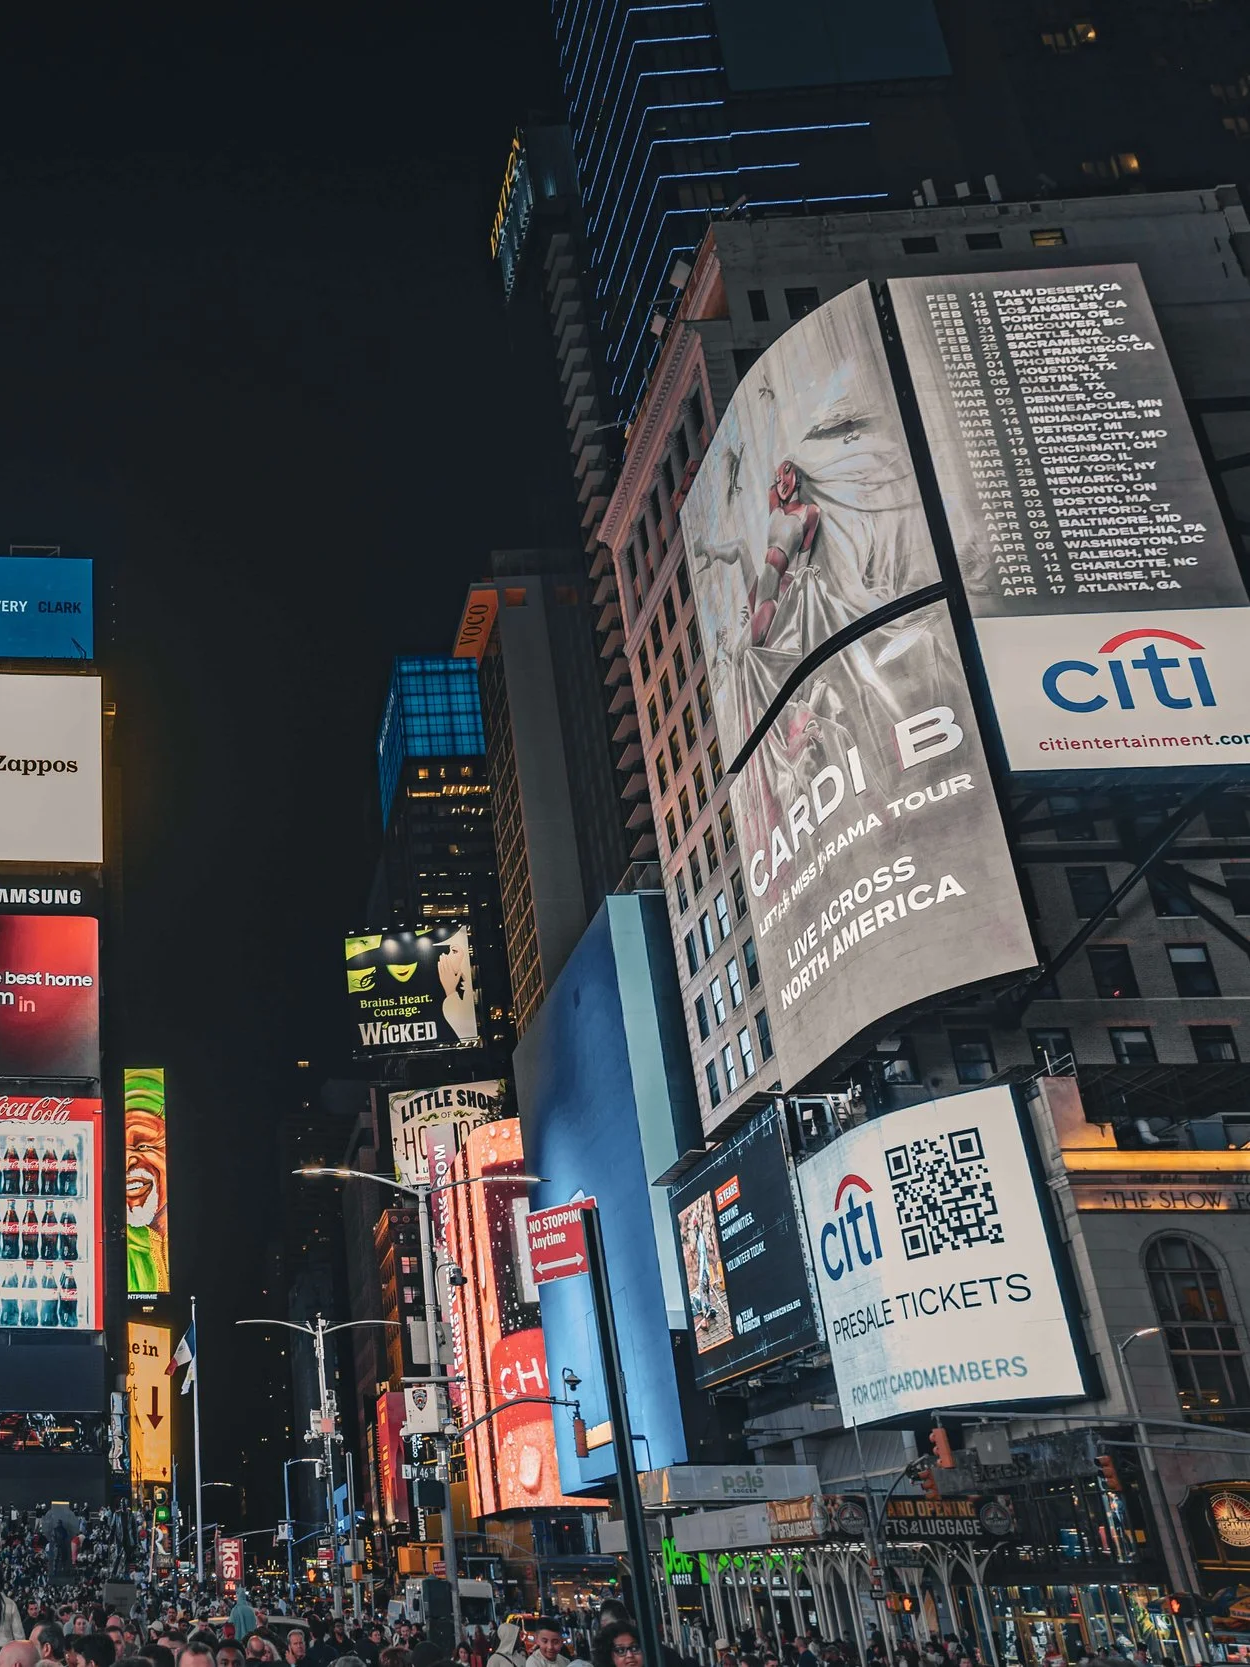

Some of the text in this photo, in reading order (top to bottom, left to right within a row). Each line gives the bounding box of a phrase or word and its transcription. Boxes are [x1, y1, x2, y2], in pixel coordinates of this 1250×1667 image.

[926, 294, 957, 303] FEB
[993, 289, 1032, 298] PALM
[1036, 285, 1097, 296] DESERT,
[1100, 283, 1122, 291] CA
[933, 319, 964, 328] FEB
[1001, 312, 1085, 324] PORTLAND,
[1088, 310, 1109, 318] OR
[949, 373, 1101, 388] MAR 06 AUSTIN, TX
[962, 428, 995, 438] MAR
[1032, 422, 1101, 435] DETROIT,
[1104, 422, 1122, 430] MI
[970, 453, 1133, 469] MAR 21 CHICAGO, IL
[984, 503, 1170, 520] APR 03 HARTFORD, CT
[1004, 580, 1181, 597] APR 17 ATLANTA, GA
[37, 600, 82, 615] CLARK
[1042, 643, 1217, 713] citi
[750, 706, 964, 898] CARDI B
[791, 863, 816, 902] MISS
[887, 773, 975, 819] TOUR
[786, 856, 916, 970] LIVE ACROSS
[781, 874, 967, 1010] NORTH AMERICA
[6, 971, 41, 986] best
[45, 973, 93, 988] home
[19, 997, 35, 1013] in
[360, 994, 432, 1009] Brains. Heart.
[373, 1006, 420, 1017] Courage.
[401, 1089, 452, 1124] LITTLE
[441, 1111, 451, 1119] OF
[723, 1181, 738, 1200] YEARS
[1106, 1192, 1152, 1208] THE
[1159, 1192, 1222, 1208] SHOW
[719, 1204, 739, 1226] SERVING
[529, 1220, 541, 1233] NO
[722, 1212, 754, 1242] COMMUNITIES.
[532, 1232, 566, 1250] Anytime
[820, 1192, 883, 1282] citi
[726, 1248, 751, 1272] VOLUNTEER
[741, 1307, 754, 1322] TEAM
[832, 1273, 1032, 1344] PRESALE TICKETS
[742, 1315, 761, 1333] RUBICON
[142, 1340, 158, 1357] in
[852, 1385, 868, 1406] FOR
[890, 1355, 1028, 1396] CARDMEMBERS
[412, 1467, 418, 1478] W
[419, 1469, 428, 1479] 46
[916, 1502, 976, 1518] OPENING
[220, 1540, 238, 1578] tkts
[672, 1574, 692, 1584] SOCCER
